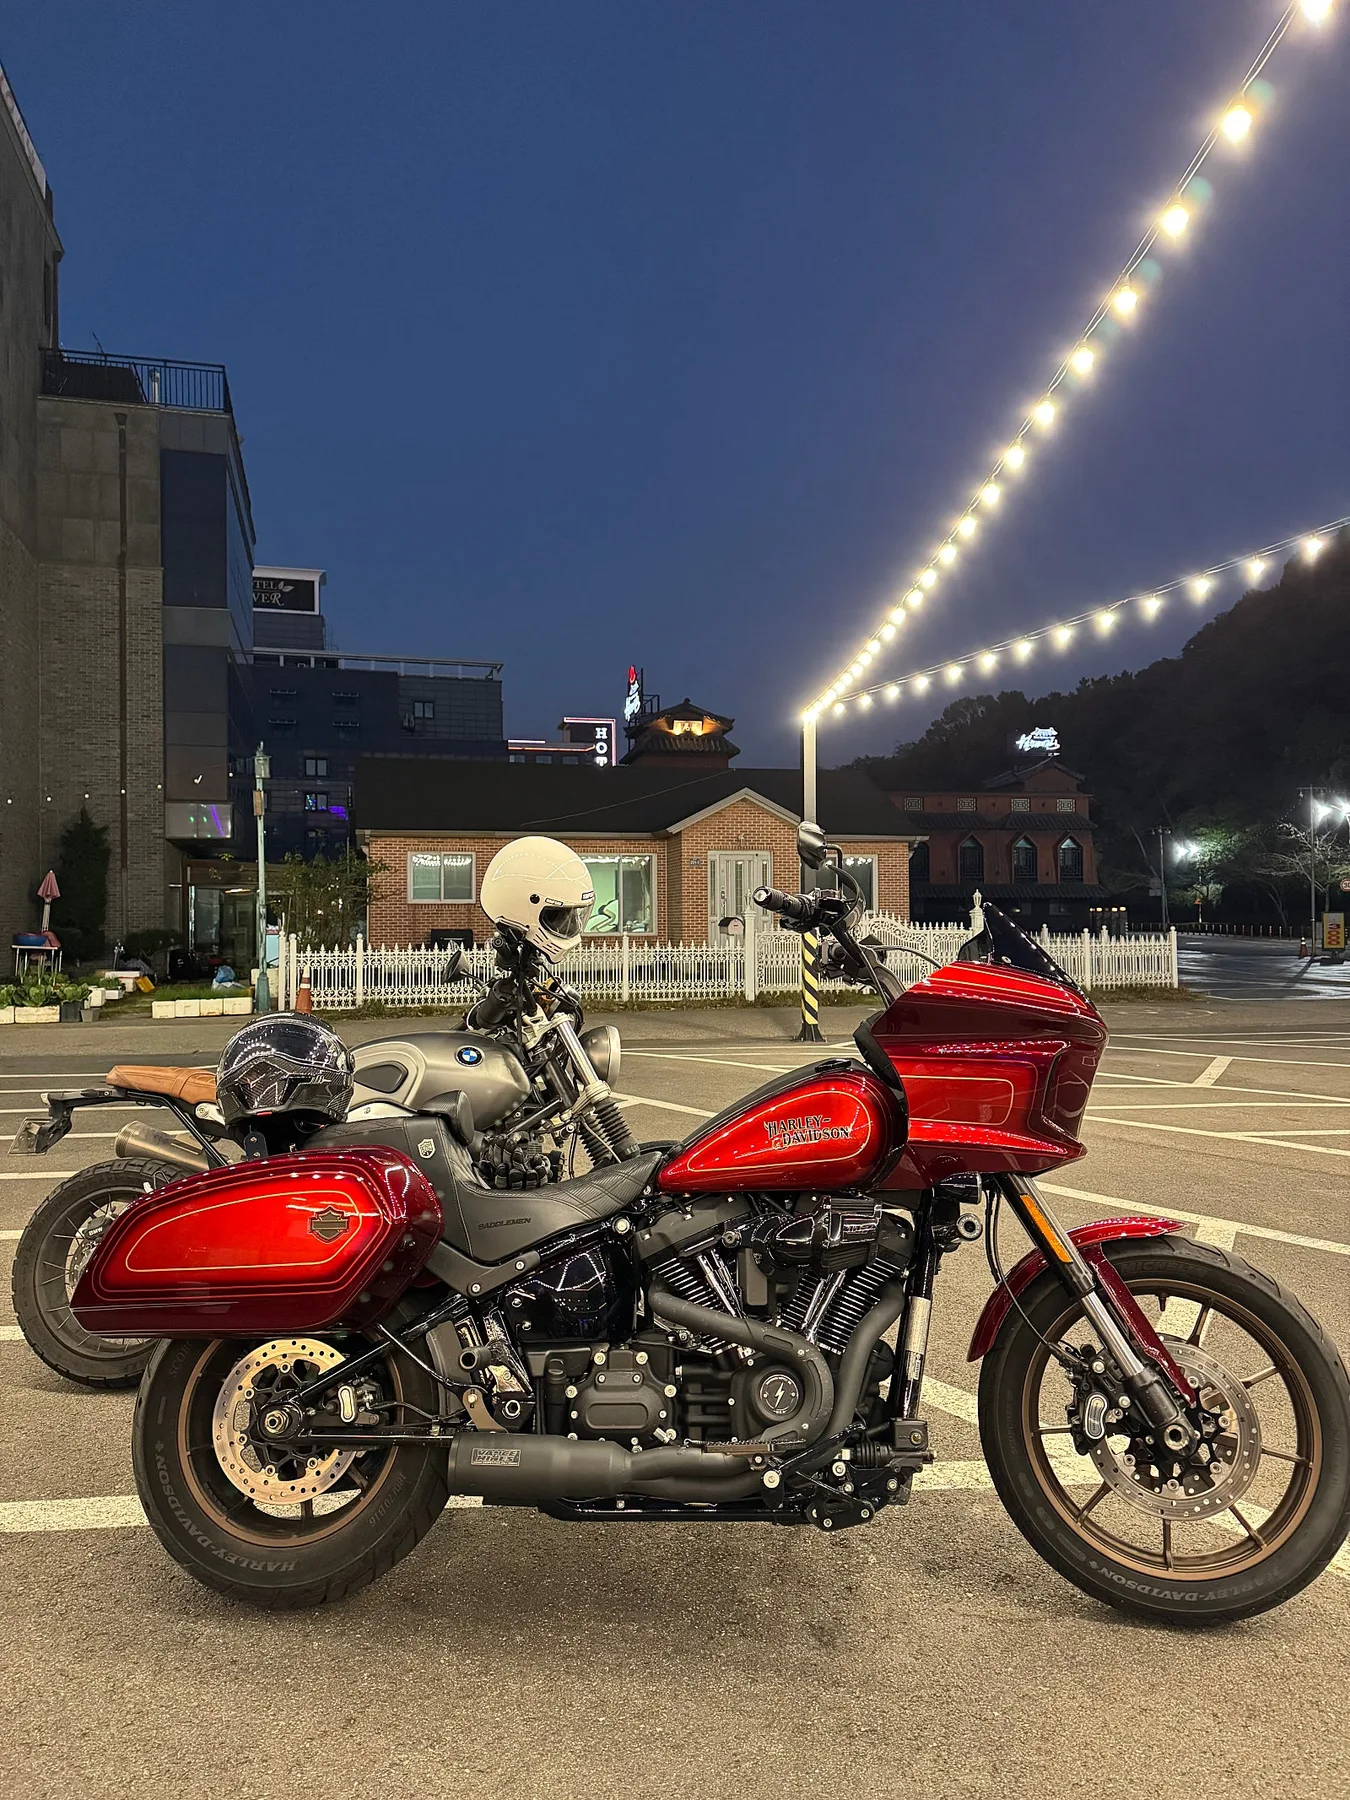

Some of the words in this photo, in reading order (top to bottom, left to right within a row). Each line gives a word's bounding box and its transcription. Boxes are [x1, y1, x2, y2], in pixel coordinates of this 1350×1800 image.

[253, 580, 277, 590] TEL
[782, 1125, 851, 1146] DAVIDSON
[478, 1217, 531, 1230] SADDLEMEN
[88, 1226, 103, 1236] BMW
